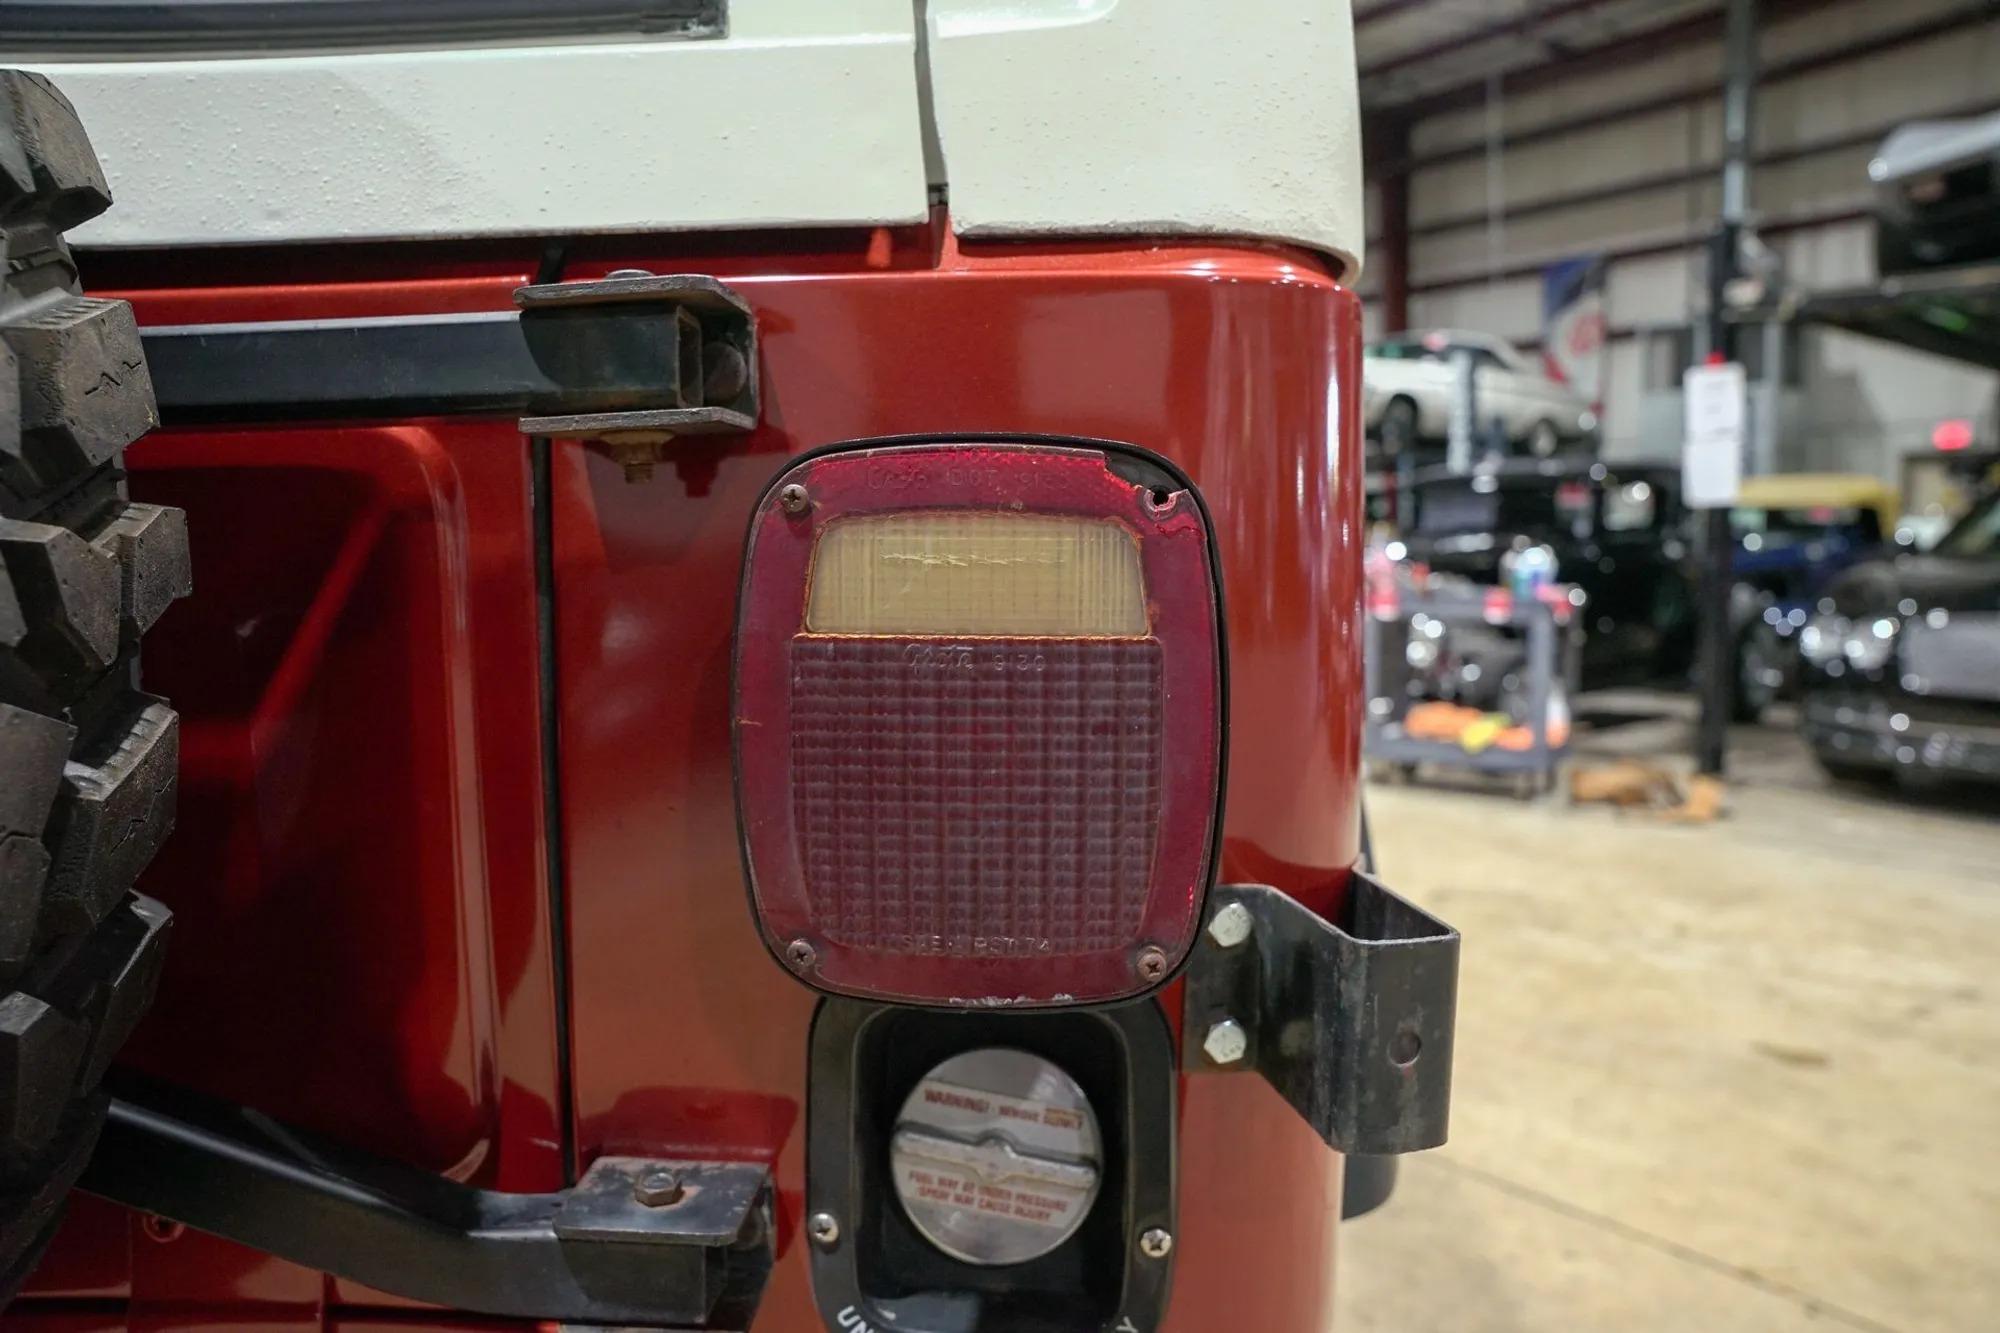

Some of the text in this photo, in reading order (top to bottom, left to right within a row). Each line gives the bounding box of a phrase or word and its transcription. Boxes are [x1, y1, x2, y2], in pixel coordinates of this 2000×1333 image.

[925, 1088, 990, 1112] WARNING!
[999, 1105, 1040, 1121] REMOVE
[937, 1176, 959, 1189] MAY
[962, 1180, 976, 1192] BE
[978, 1184, 1012, 1201] UNDER
[1014, 1192, 1067, 1212] PRESSURE
[953, 1191, 975, 1205] MAY
[977, 1197, 1012, 1213] CAUSE
[1013, 1204, 1051, 1221] INJURY
